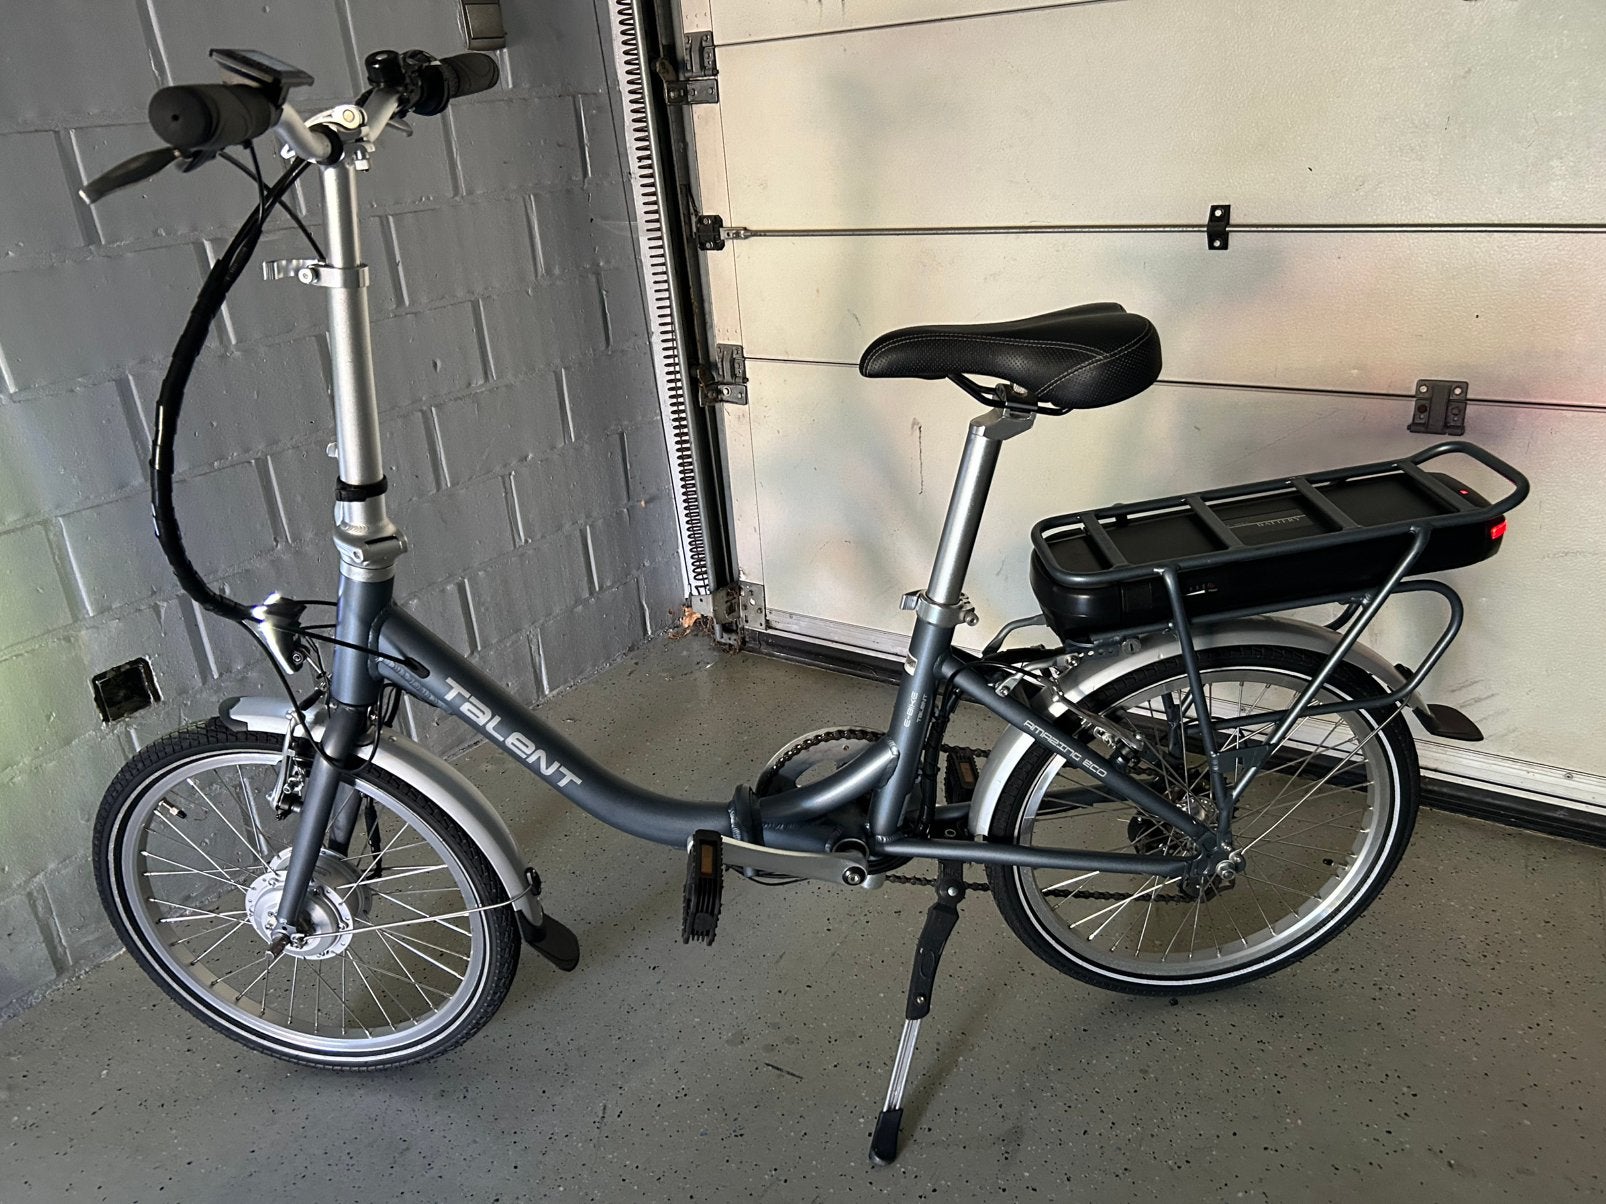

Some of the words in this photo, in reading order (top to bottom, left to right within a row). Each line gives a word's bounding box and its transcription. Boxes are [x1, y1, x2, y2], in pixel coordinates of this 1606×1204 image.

[903, 690, 919, 728] E-BIKE
[1023, 719, 1082, 761] AMAZING
[1082, 758, 1108, 778] ECO
